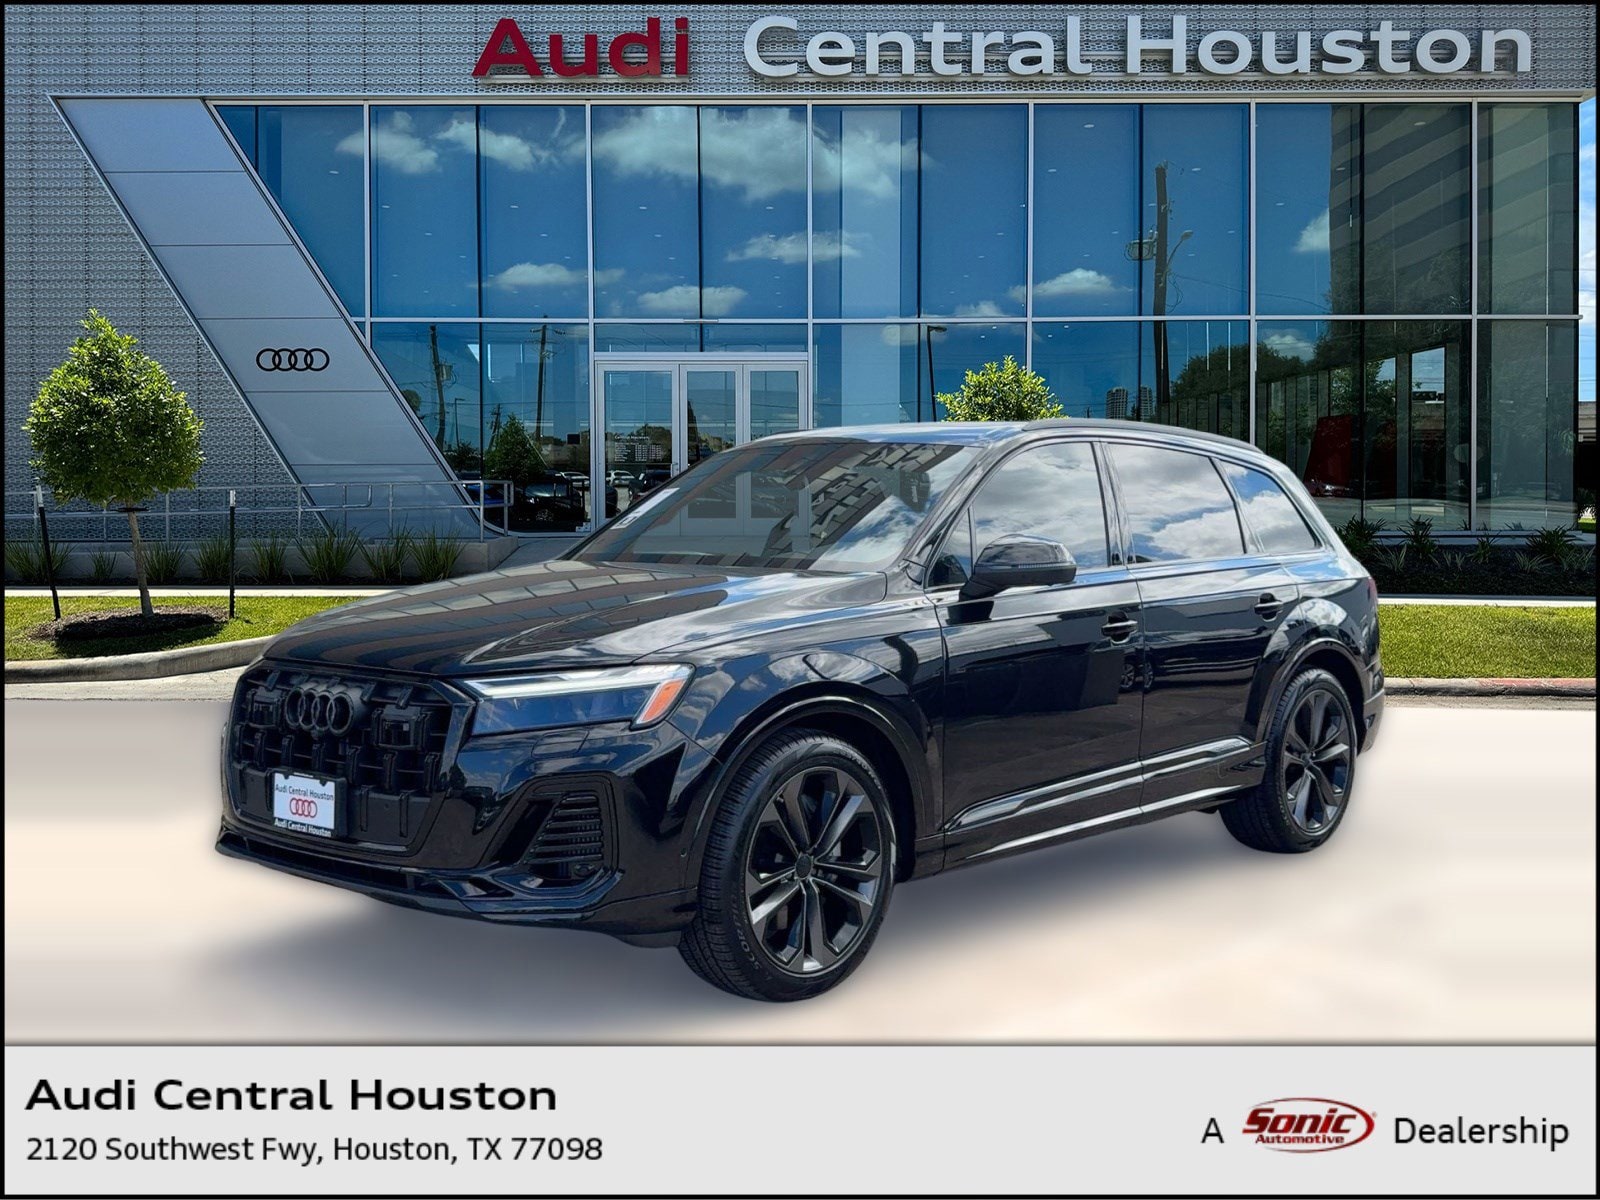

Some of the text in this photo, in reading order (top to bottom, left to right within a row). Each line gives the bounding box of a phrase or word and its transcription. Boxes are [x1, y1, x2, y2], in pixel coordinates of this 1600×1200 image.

[471, 15, 1532, 78] Audi Central Houston
[275, 784, 334, 801] Audi Central Houston
[274, 818, 331, 837] Audi Central Houston
[730, 884, 762, 970] SCORPIO
